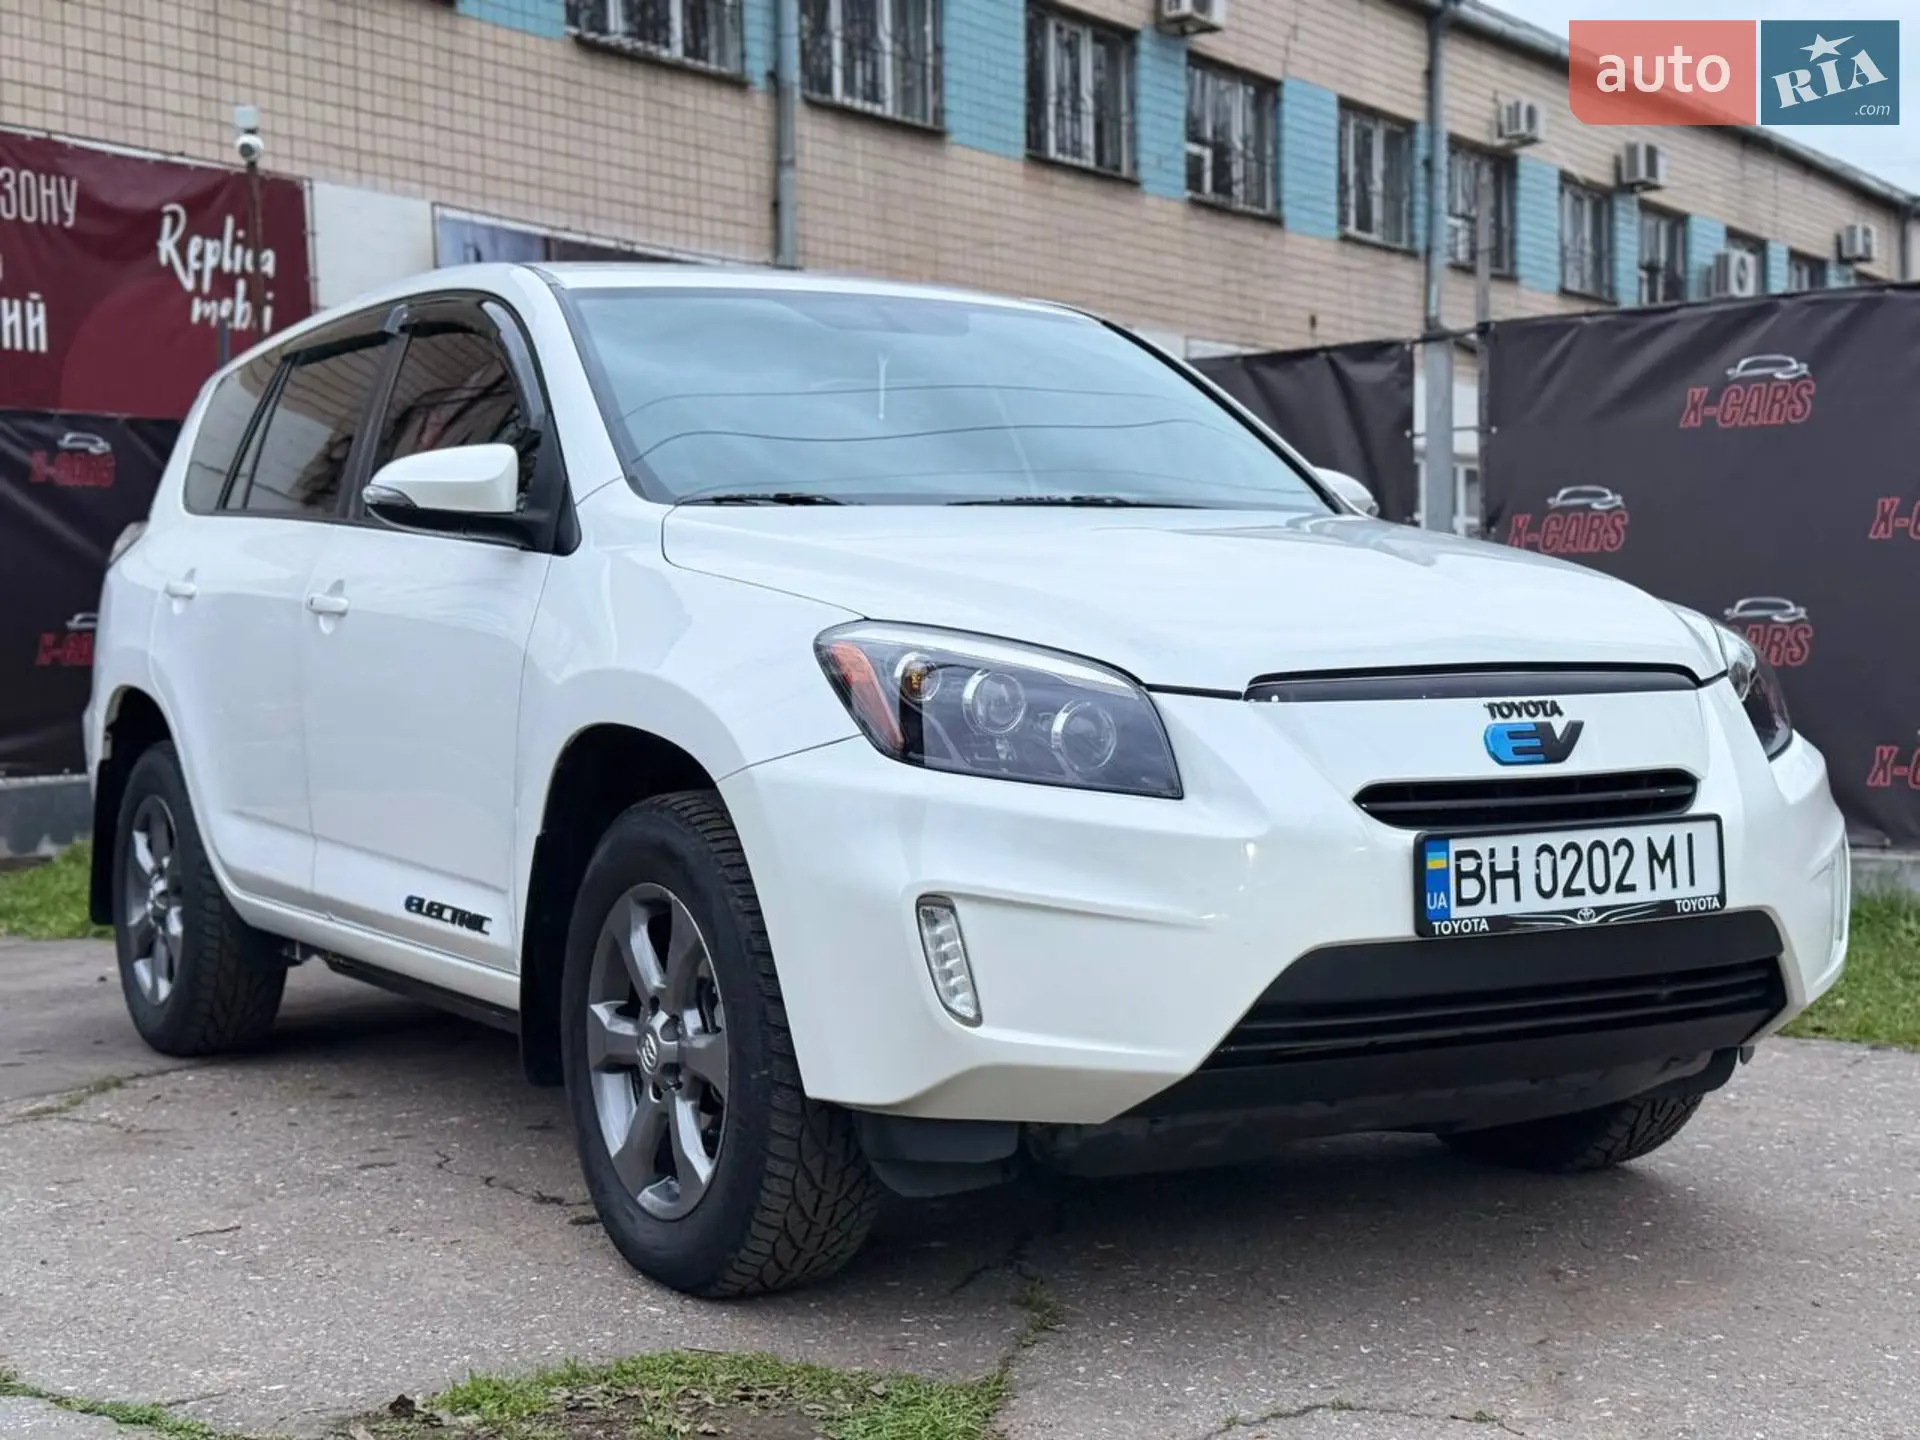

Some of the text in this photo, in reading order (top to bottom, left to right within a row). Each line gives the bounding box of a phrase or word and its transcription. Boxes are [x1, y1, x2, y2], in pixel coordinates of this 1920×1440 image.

[156, 202, 276, 294] Replica
[1679, 379, 1816, 428] X-CARS
[1507, 510, 1630, 554] X-CARS
[1483, 700, 1564, 720] TOYOTA
[1483, 719, 1585, 767] EV
[1454, 832, 1697, 908] BH 0202 MI
[1426, 892, 1449, 910] UA
[1674, 895, 1721, 912] TOYOTA
[1431, 917, 1490, 935] TOYOTA
